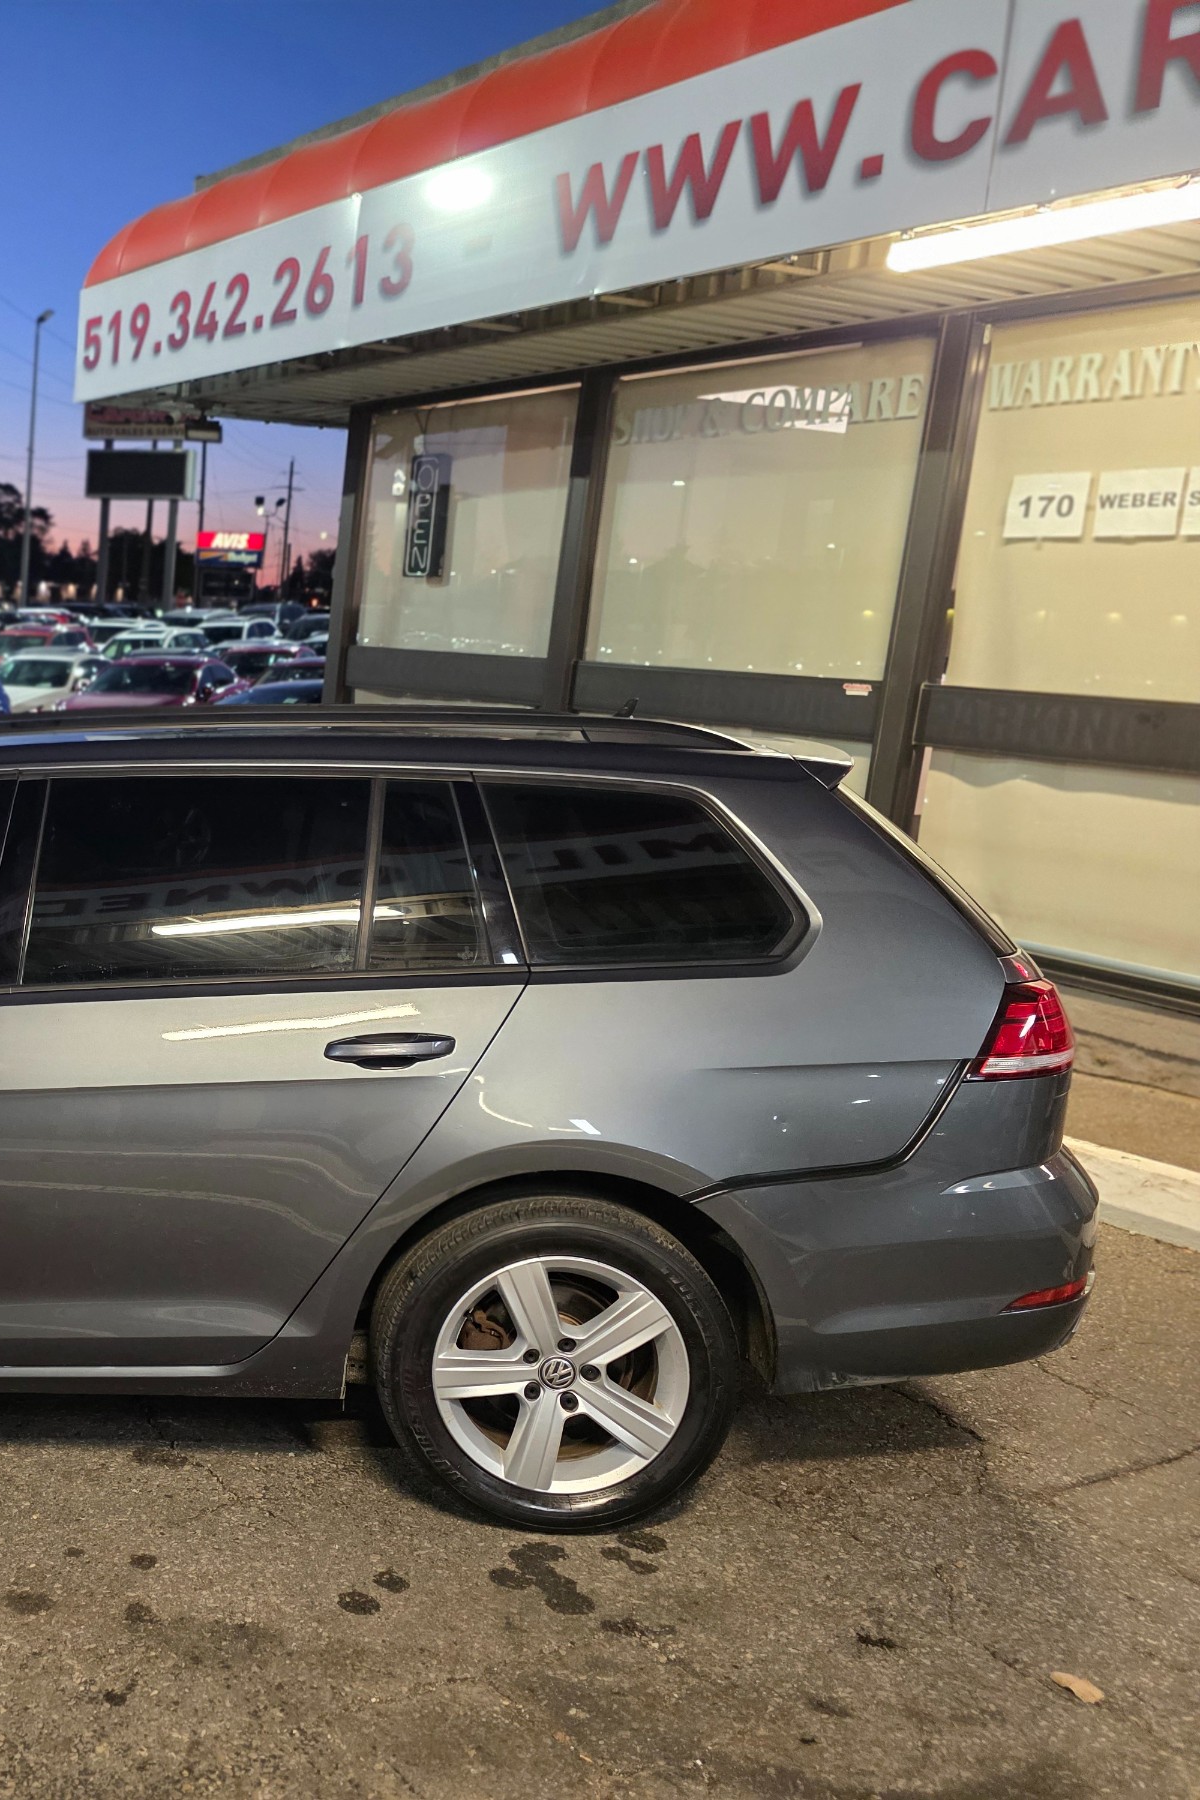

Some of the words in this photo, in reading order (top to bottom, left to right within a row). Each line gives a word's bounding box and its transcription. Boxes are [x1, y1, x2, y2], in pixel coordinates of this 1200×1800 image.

[83, 223, 415, 369] 519.342.2613
[741, 374, 925, 434] COMPARE
[988, 342, 1200, 411] WARRANT
[411, 464, 435, 569] OPEN
[1018, 494, 1075, 518] 170
[1099, 491, 1178, 509] WEBER
[210, 531, 250, 549] AVIS
